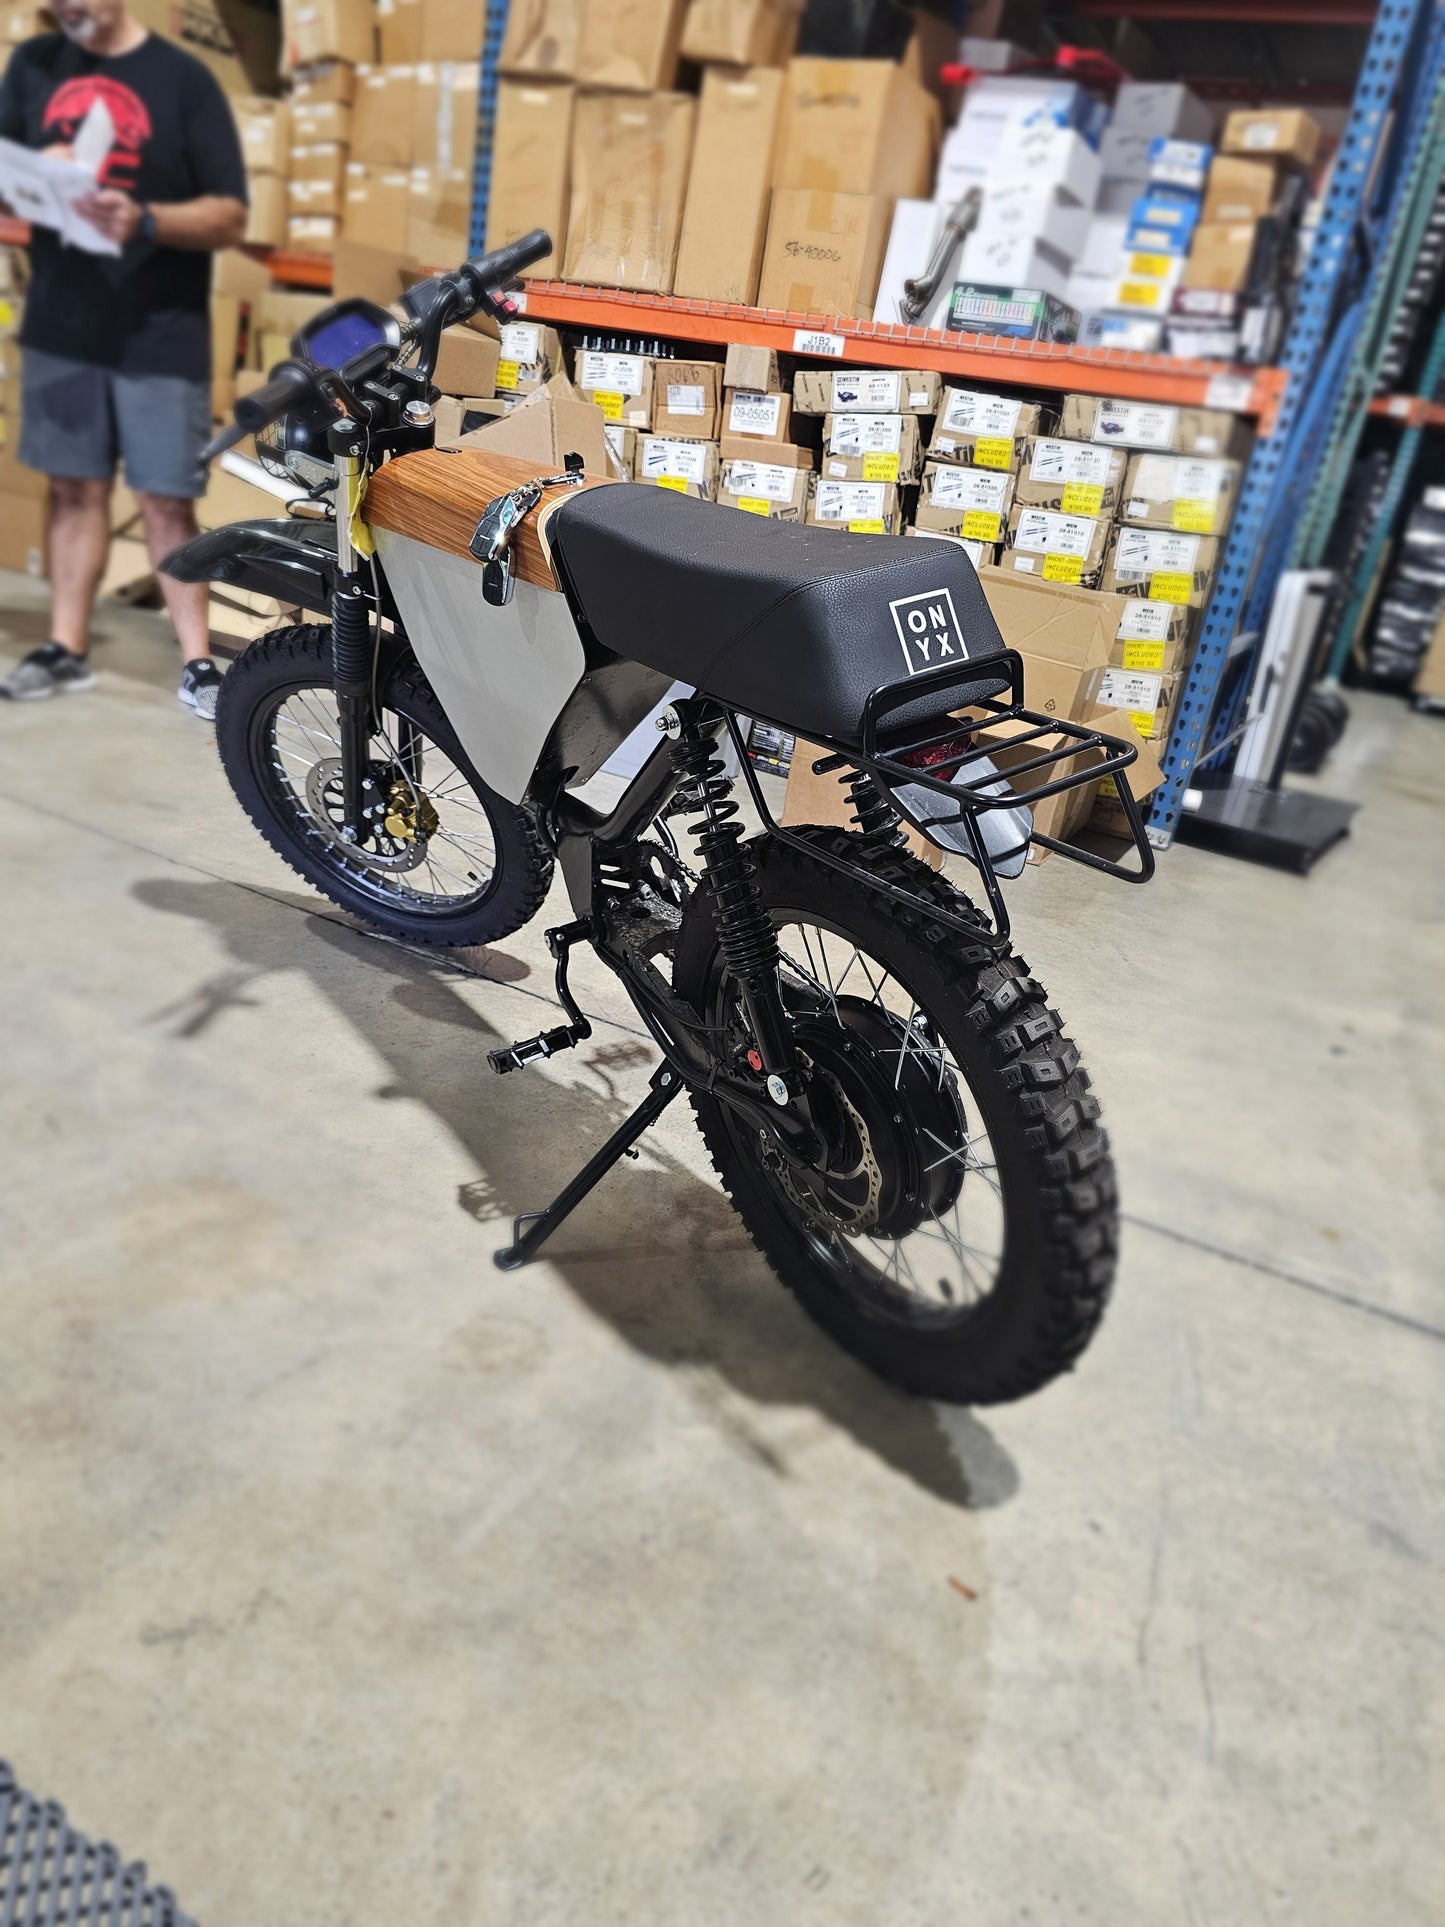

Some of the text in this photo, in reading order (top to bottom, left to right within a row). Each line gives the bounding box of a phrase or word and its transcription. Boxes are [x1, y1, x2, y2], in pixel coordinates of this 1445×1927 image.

[807, 335, 831, 346] J1B2
[733, 406, 776, 422] 09-05051
[907, 604, 947, 634] ON
[914, 632, 955, 661] YX
